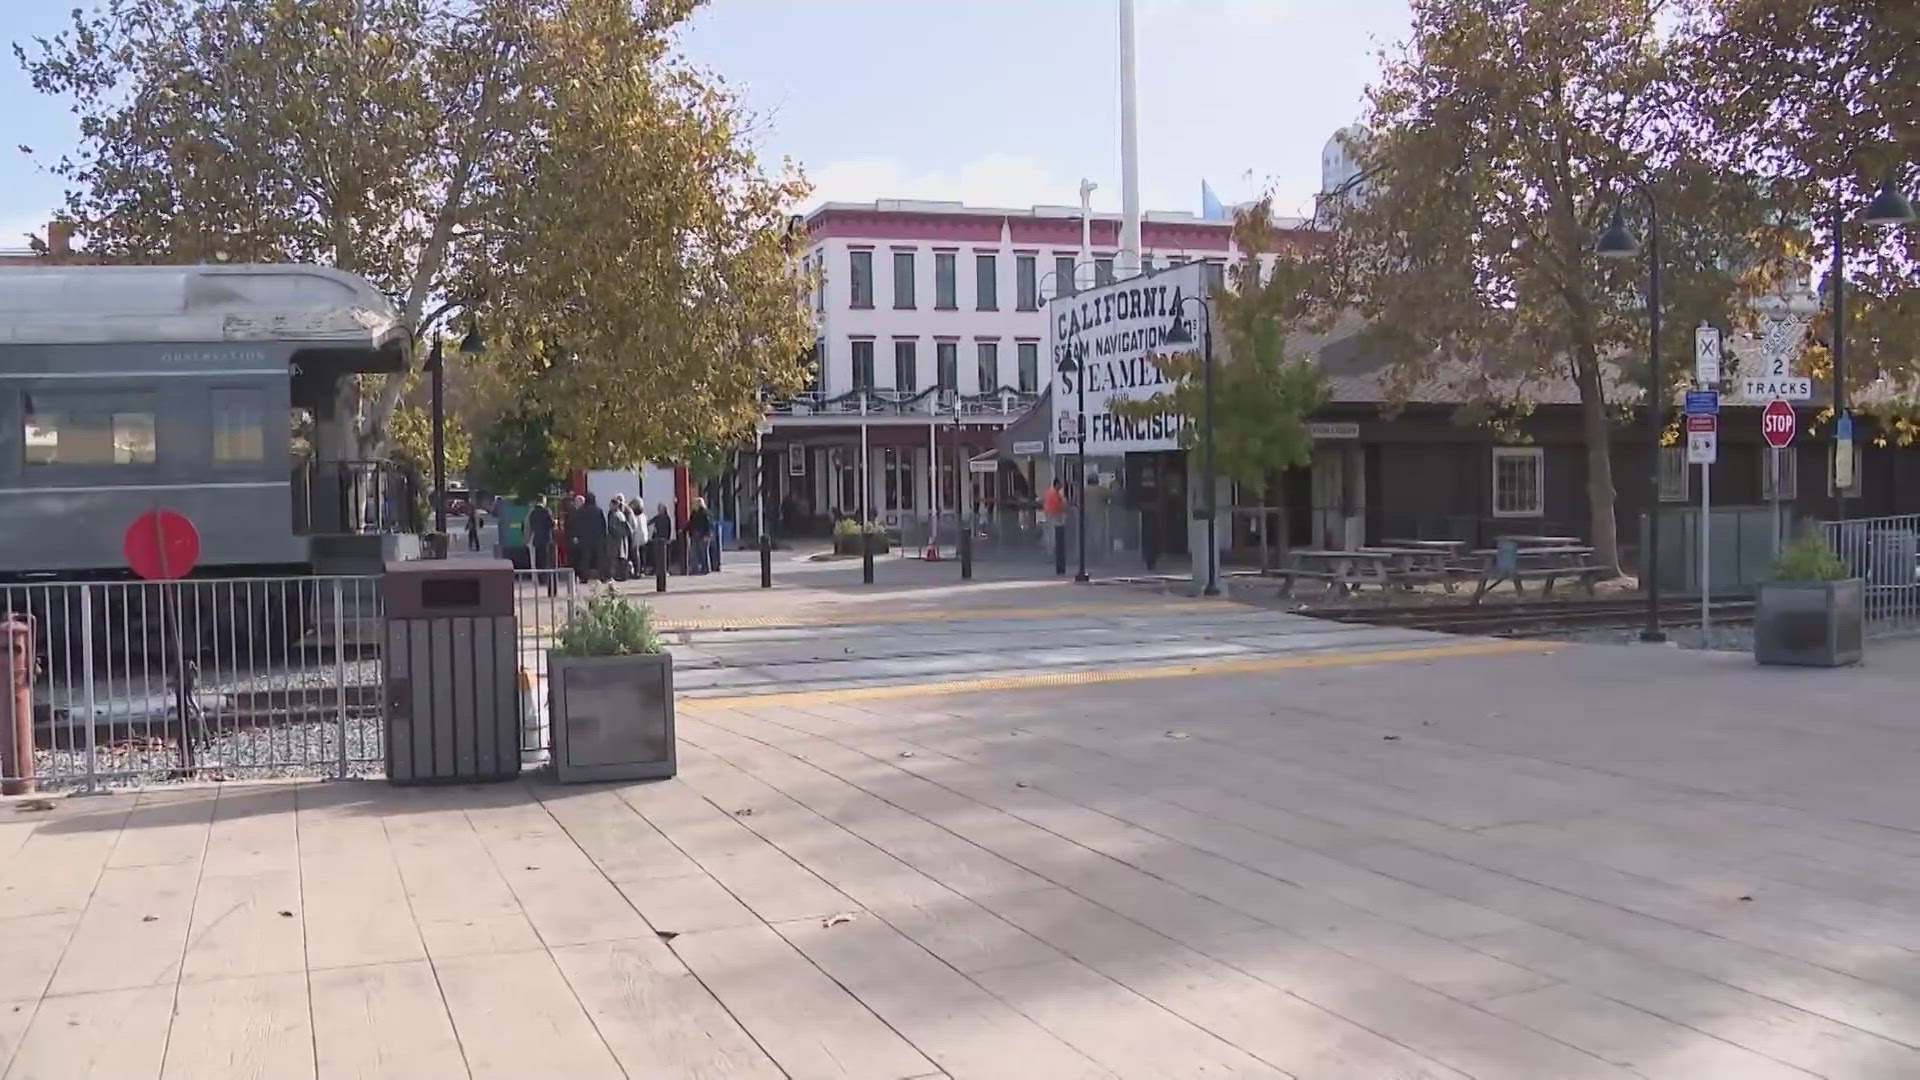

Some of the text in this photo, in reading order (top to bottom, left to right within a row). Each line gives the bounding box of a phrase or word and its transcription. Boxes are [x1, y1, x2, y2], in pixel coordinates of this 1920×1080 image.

[1058, 286, 1184, 341] CALIFORNIA
[1096, 325, 1167, 357] NAVIGATION
[1773, 359, 1783, 375] 2
[1747, 383, 1808, 394] TRACKS
[1766, 415, 1792, 432] STOP
